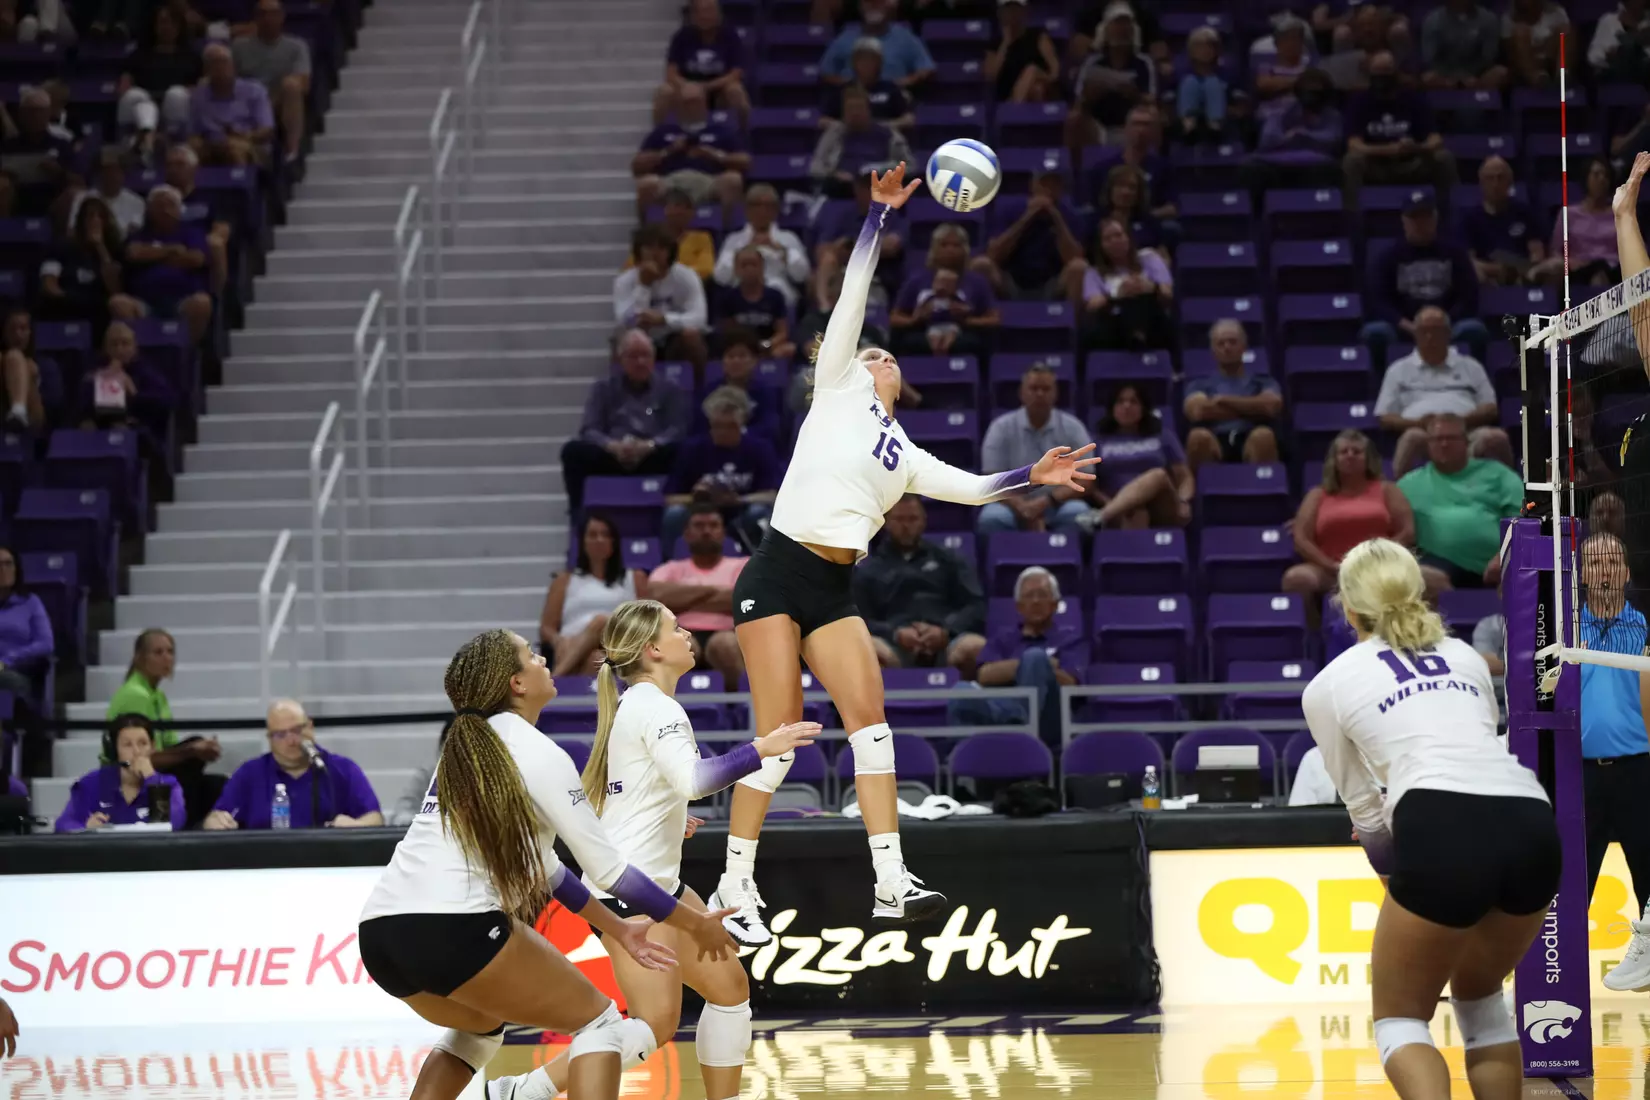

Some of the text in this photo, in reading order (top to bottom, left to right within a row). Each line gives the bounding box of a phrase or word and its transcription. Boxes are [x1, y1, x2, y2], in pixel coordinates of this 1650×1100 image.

[872, 431, 904, 471] 15
[1377, 645, 1451, 684] 16
[1378, 679, 1479, 714] WILDCATS
[734, 905, 1092, 985] izza Hut
[1541, 912, 1561, 983] imports
[0, 940, 296, 993] SMOOTHIE
[1530, 1060, 1580, 1069] (800) 556-3198
